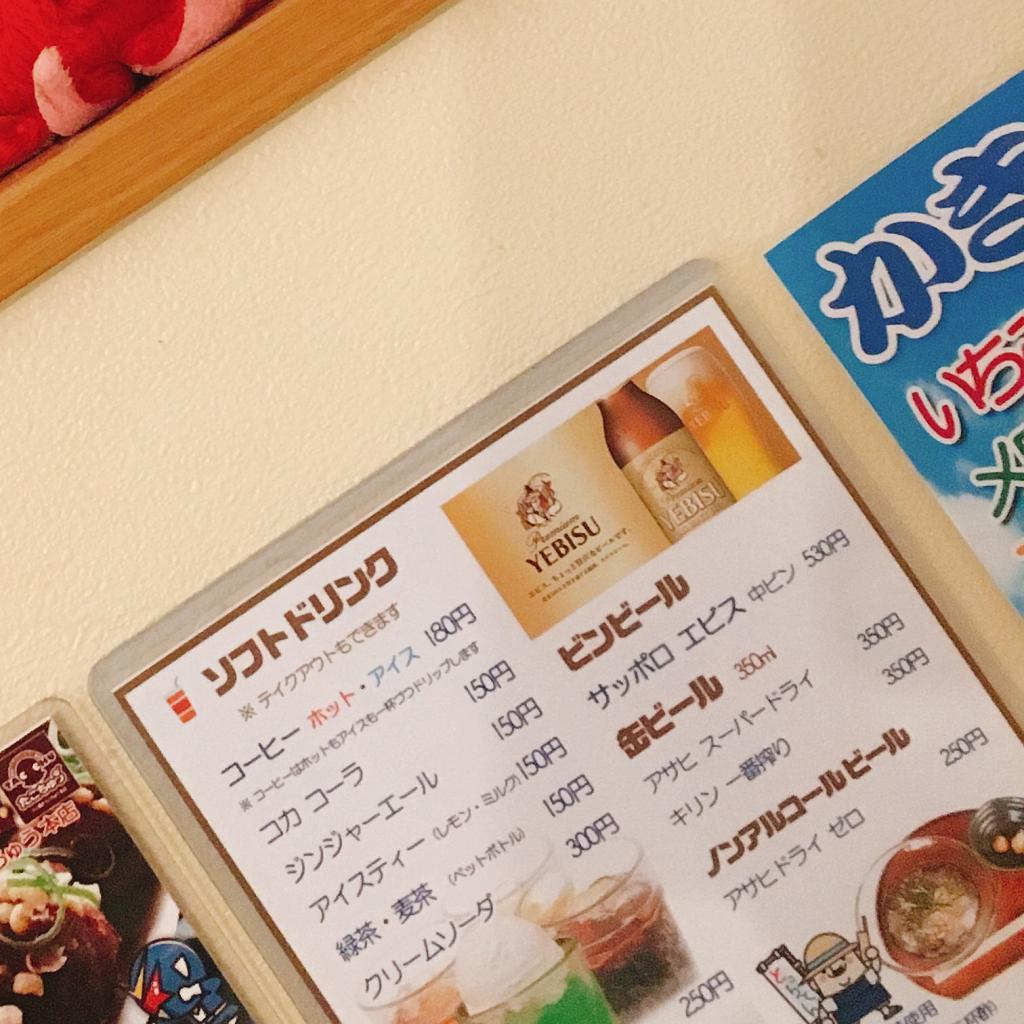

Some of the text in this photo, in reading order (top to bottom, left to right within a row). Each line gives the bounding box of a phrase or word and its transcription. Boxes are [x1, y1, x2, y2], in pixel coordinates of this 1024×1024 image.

[907, 316, 1024, 440] いち
[526, 516, 602, 576] YEBISU
[528, 513, 580, 549] Premium
[202, 547, 398, 697] ソフトドリンク
[257, 603, 400, 709] テイクアウトもできます
[557, 574, 690, 671] ビンビール
[588, 643, 675, 710] サッポロ
[802, 529, 850, 567] 530円
[221, 728, 300, 787] コーヒー
[424, 603, 476, 646] 180円
[259, 660, 516, 844] コカ コーラ 150円
[617, 675, 723, 759] 缶ビール
[643, 612, 905, 794] アサヒ スーパードライ 350円
[670, 786, 718, 825] キリン
[882, 647, 930, 685] 350円
[285, 697, 543, 884] ジンジャーエール 150円
[309, 838, 425, 923] アイスティー
[516, 737, 567, 780] 150円
[708, 728, 910, 878] ノンアルコールビール
[829, 808, 865, 838] ゼロ
[940, 727, 989, 767] 250円
[336, 883, 437, 961] 緑茶・麦茶
[543, 774, 594, 817] 150円
[365, 813, 619, 1000] クリームソーダ 300円
[679, 970, 734, 1018] 250円
